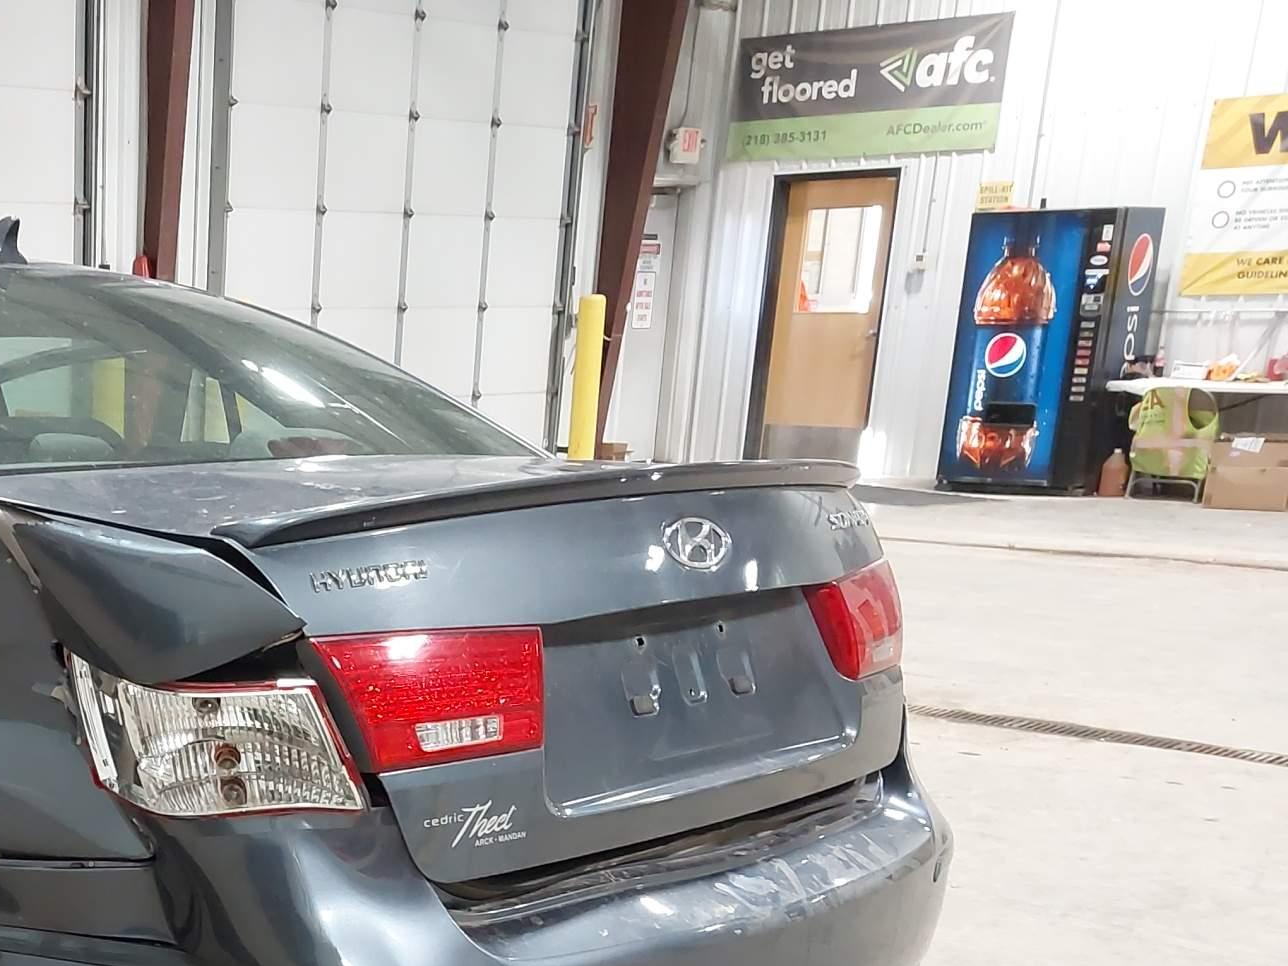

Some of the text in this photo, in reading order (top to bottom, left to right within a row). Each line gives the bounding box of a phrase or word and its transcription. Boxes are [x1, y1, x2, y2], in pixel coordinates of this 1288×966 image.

[750, 45, 796, 79] get
[761, 69, 858, 105] floored
[885, 121, 984, 137] AFCDealer.com
[1236, 256, 1284, 266] WE CARE
[973, 369, 987, 411] pepsi
[309, 559, 428, 594] HYUNDAI
[423, 812, 464, 828] cedric
[497, 831, 527, 843] MANDAN
